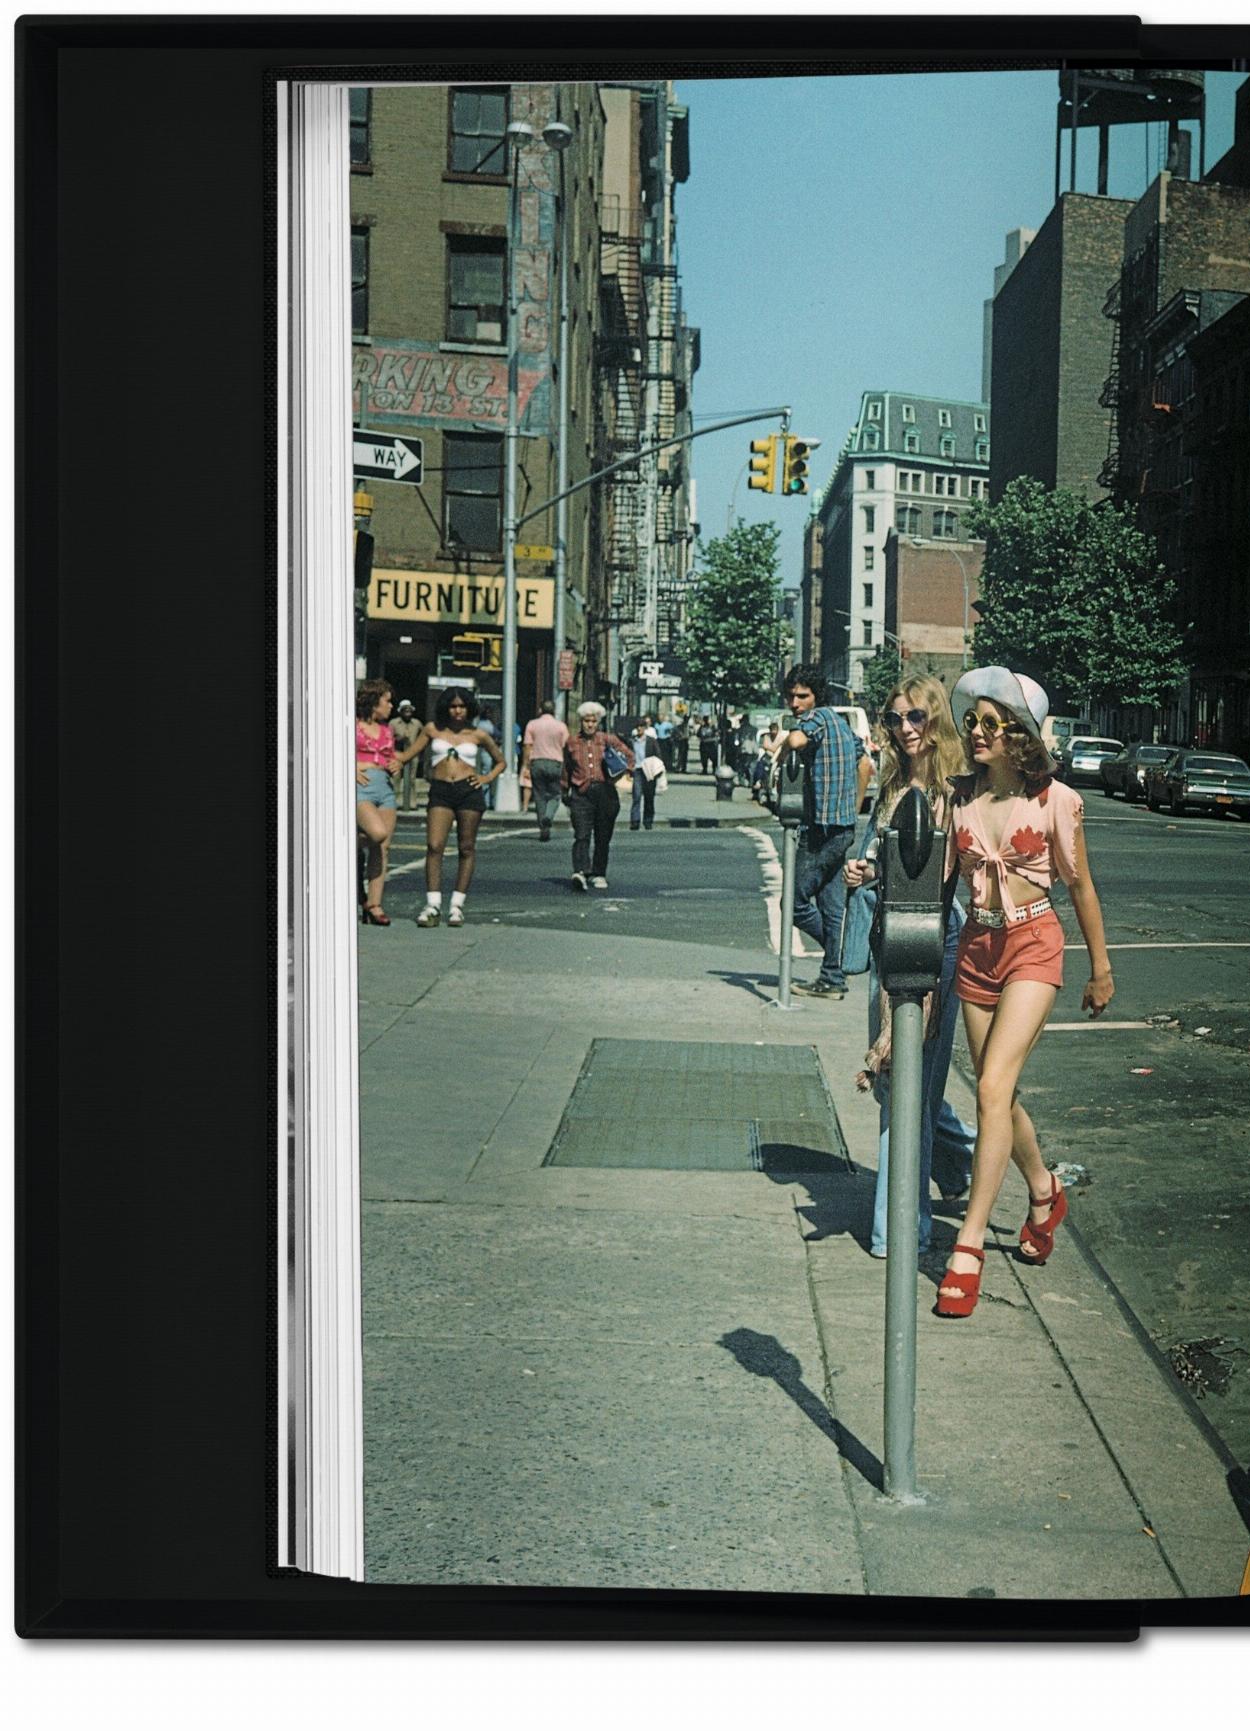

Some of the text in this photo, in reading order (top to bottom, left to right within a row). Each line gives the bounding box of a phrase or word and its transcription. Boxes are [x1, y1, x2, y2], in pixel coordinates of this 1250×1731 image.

[352, 352, 495, 396] RKING
[373, 390, 415, 411] ON
[373, 447, 407, 467] WAY
